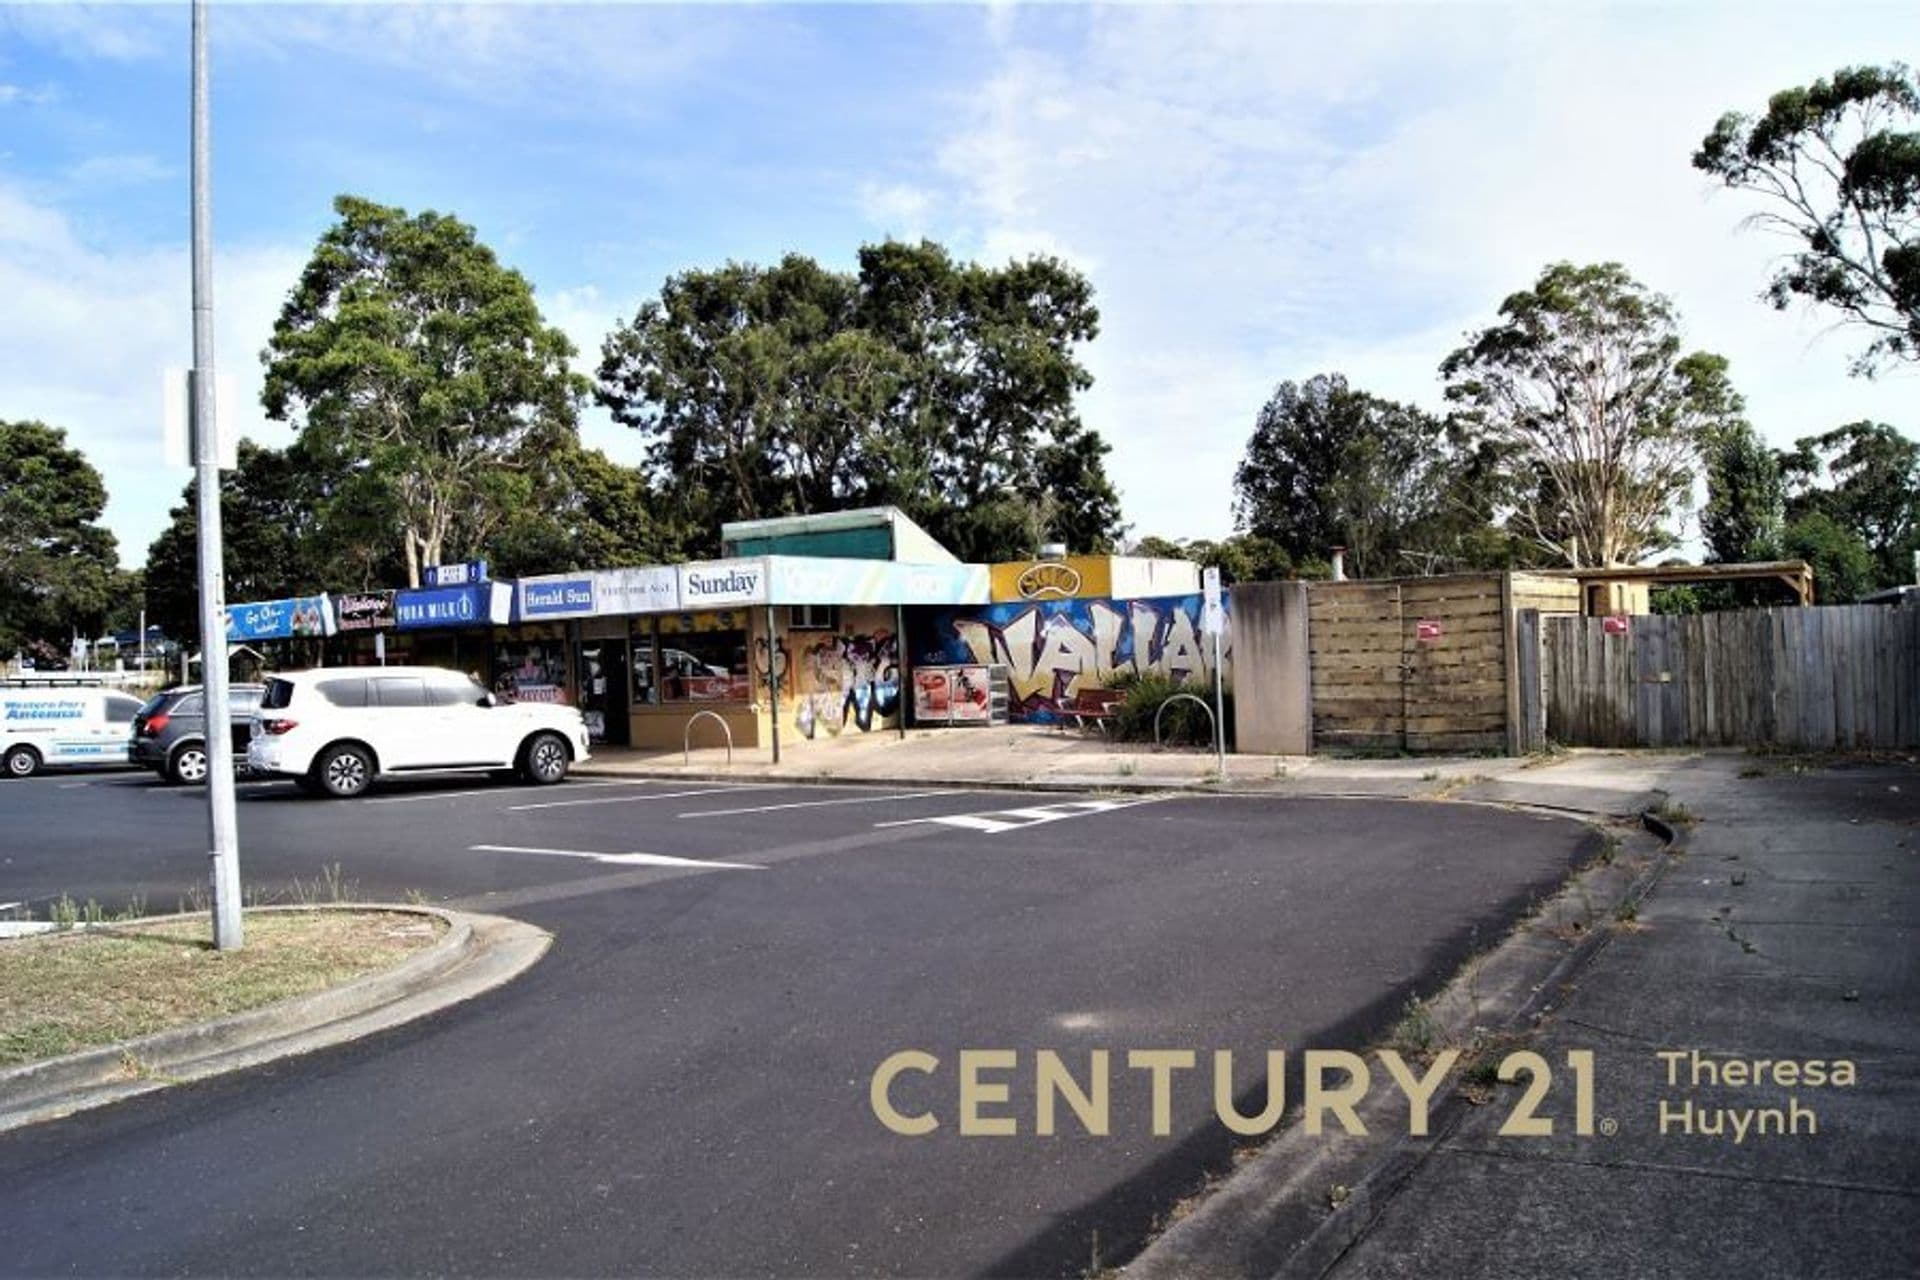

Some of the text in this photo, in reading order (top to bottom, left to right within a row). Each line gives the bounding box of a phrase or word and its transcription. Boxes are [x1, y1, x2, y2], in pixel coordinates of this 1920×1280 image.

[689, 570, 758, 595] Sunday
[527, 589, 564, 606] Herald
[567, 588, 591, 604] Sun
[428, 601, 456, 619] MILK
